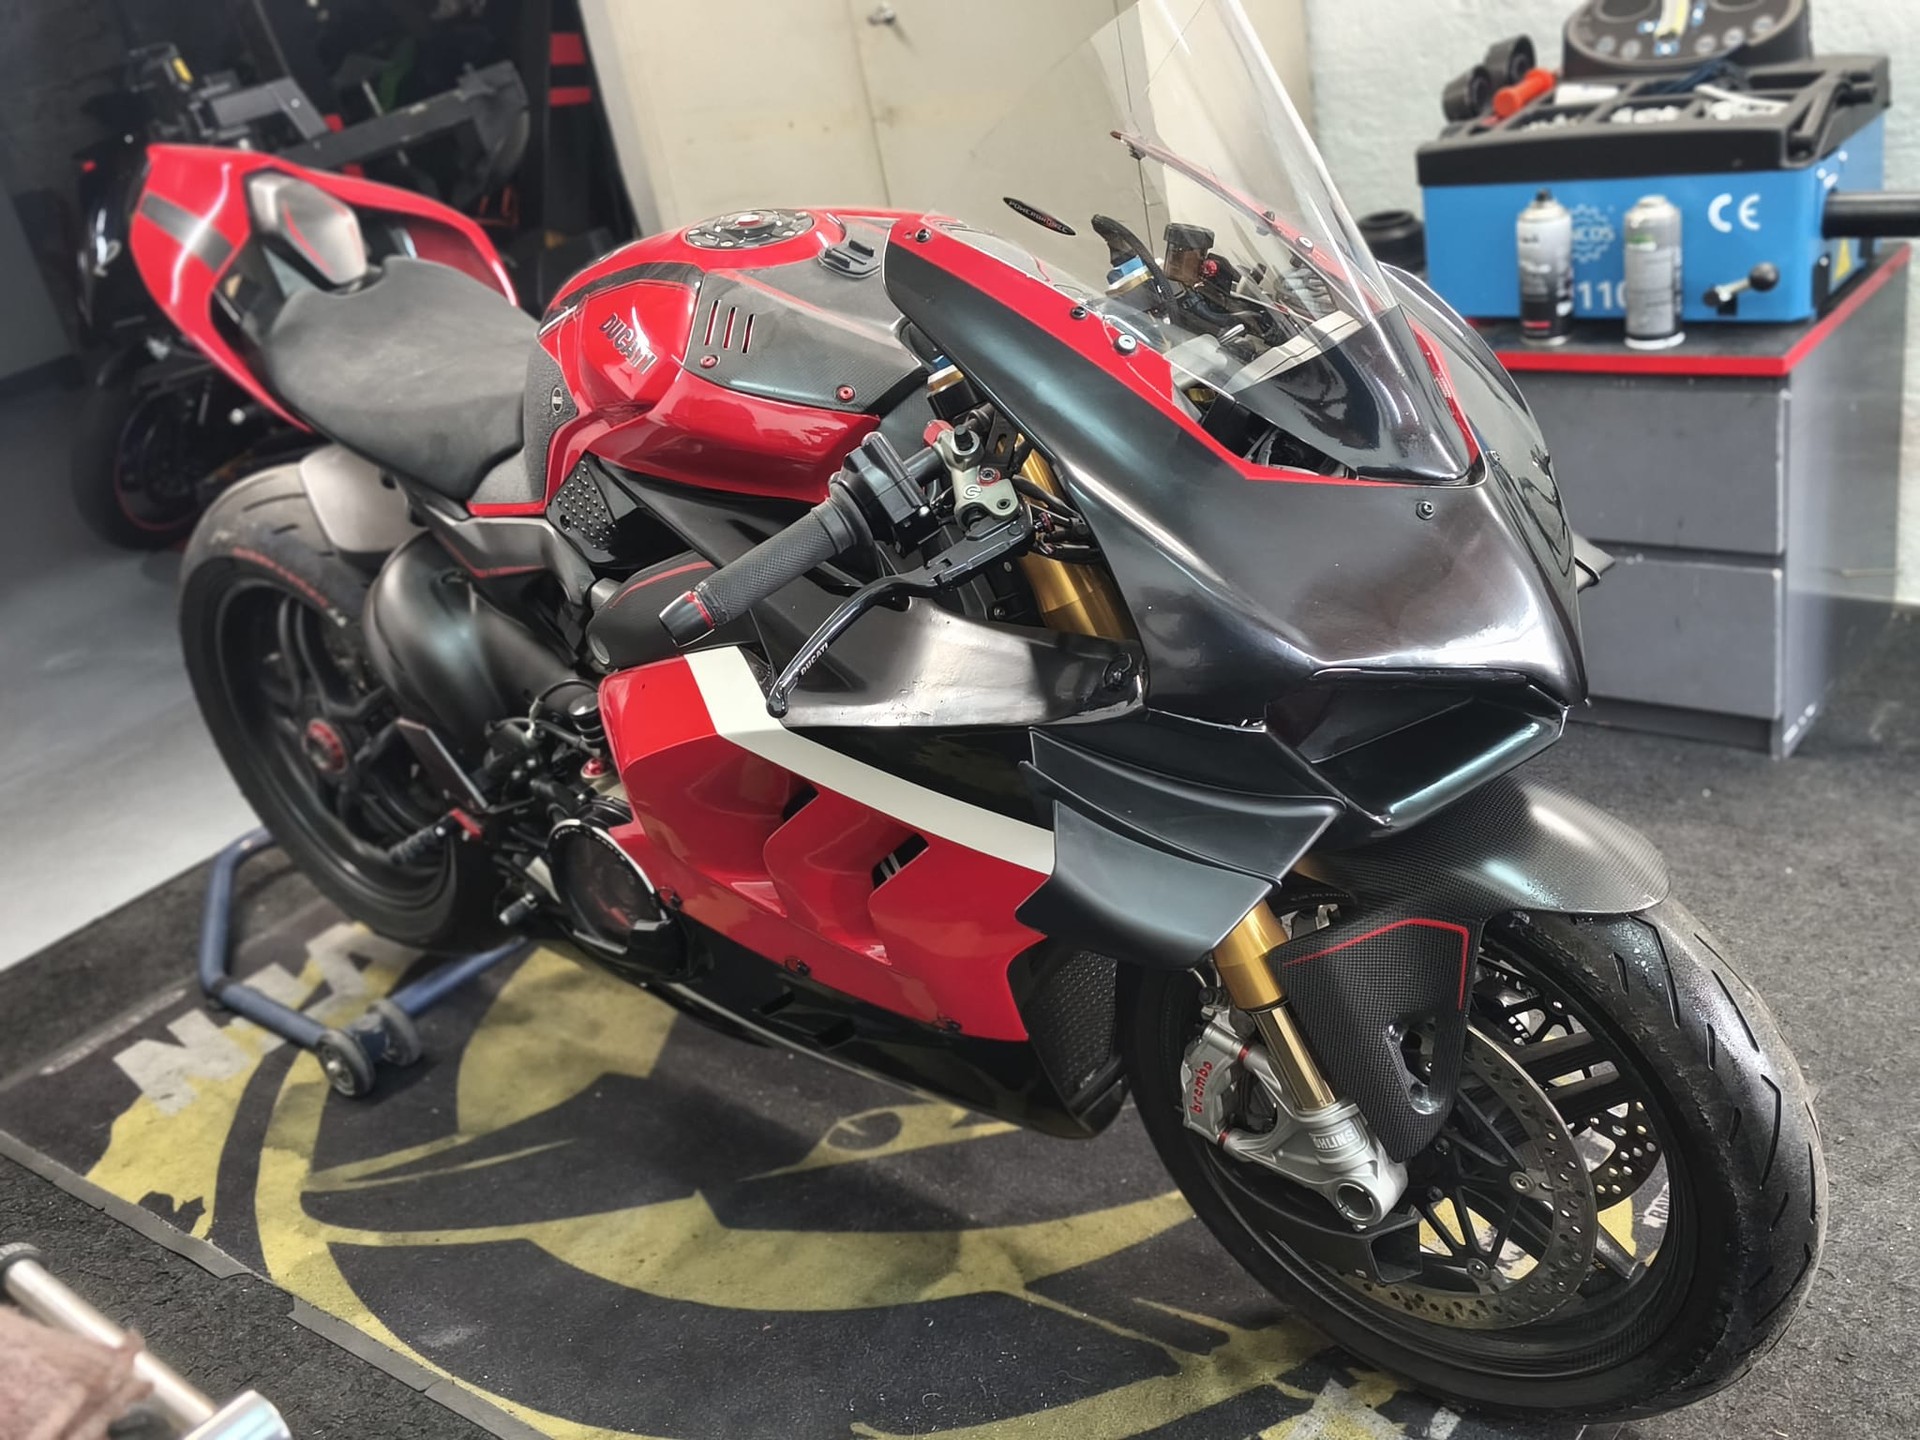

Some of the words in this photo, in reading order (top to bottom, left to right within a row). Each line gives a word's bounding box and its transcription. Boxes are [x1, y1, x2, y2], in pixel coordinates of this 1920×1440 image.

[1707, 193, 1761, 232] CE
[800, 641, 829, 676] DUCATI
[1189, 1060, 1213, 1114] brembo
